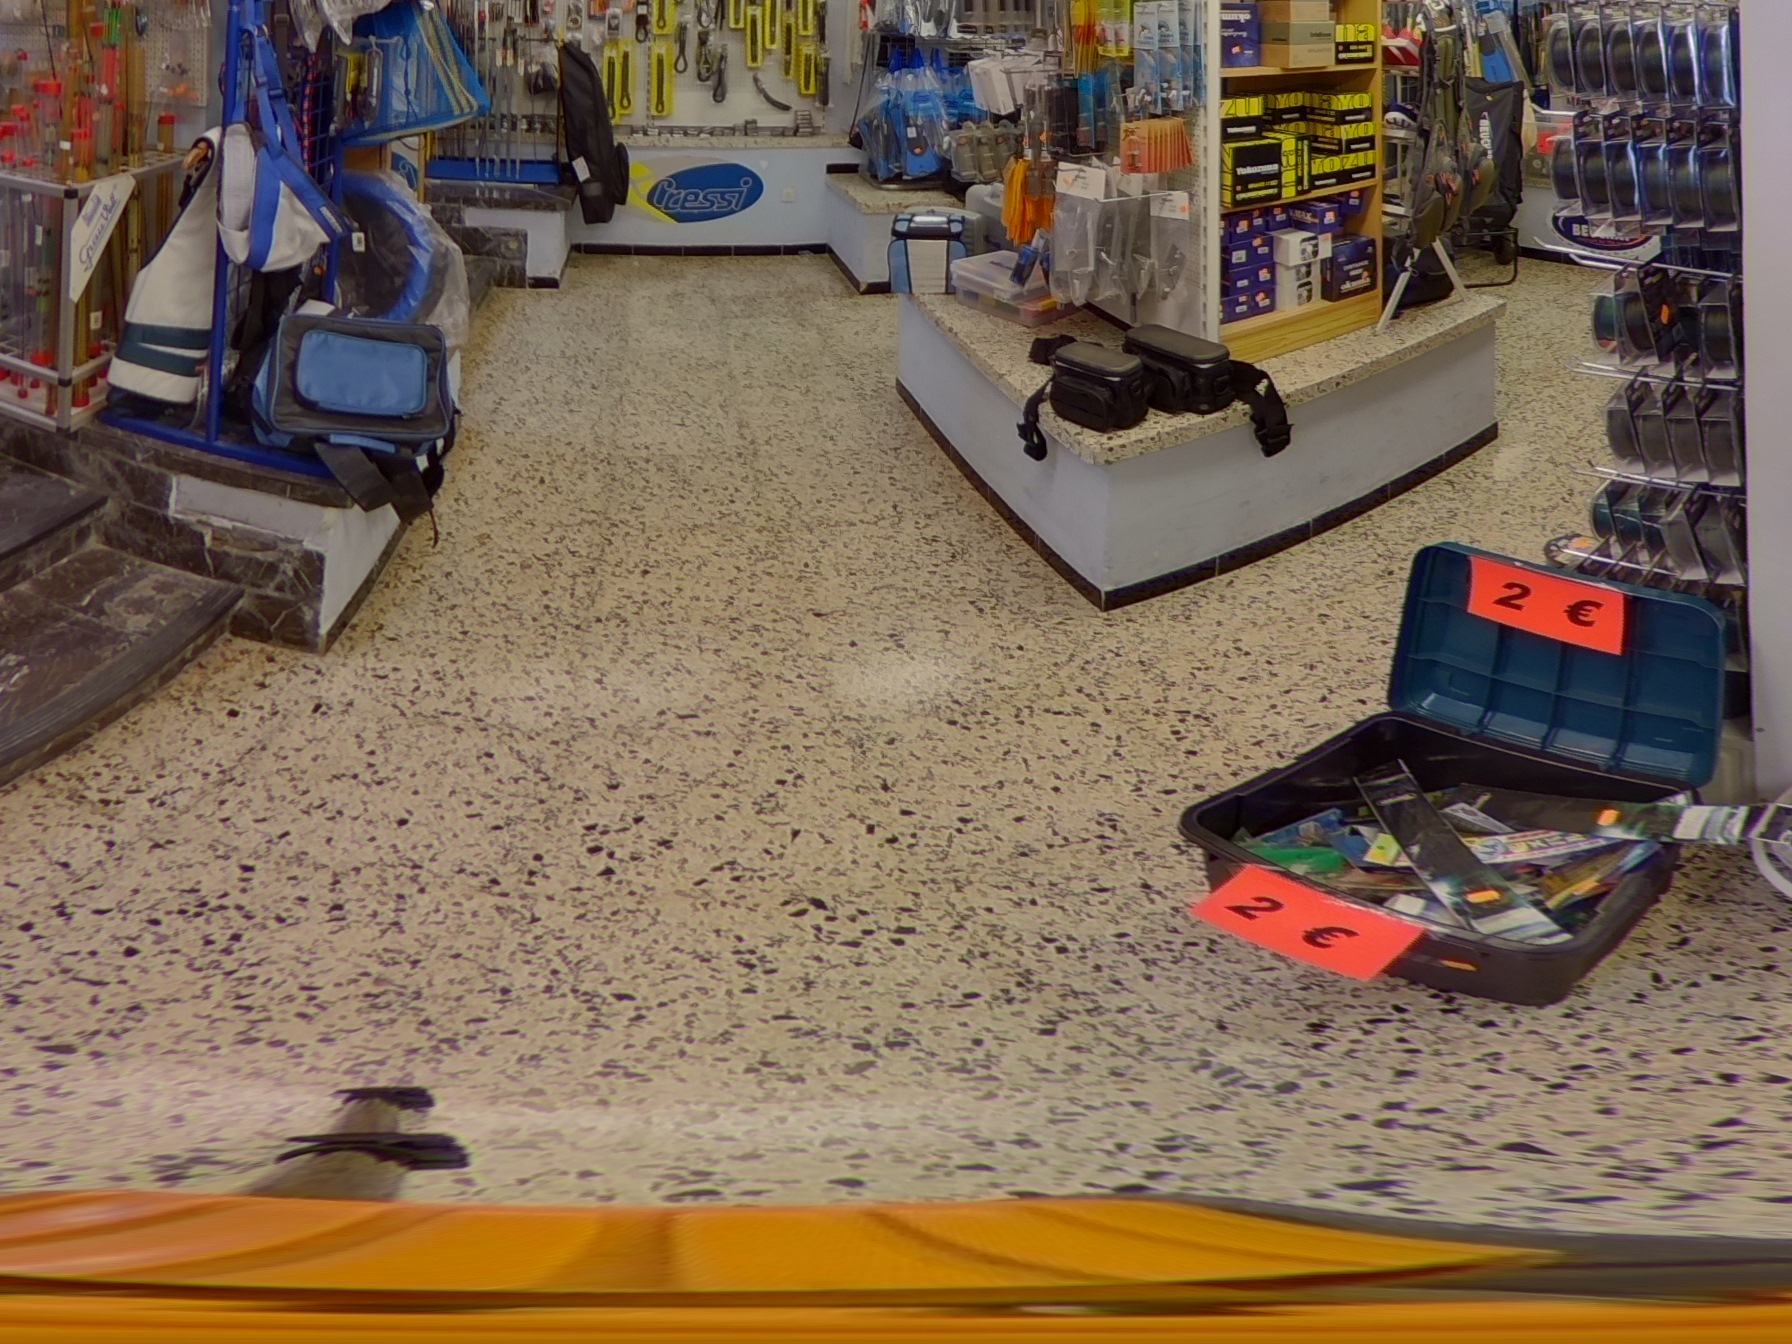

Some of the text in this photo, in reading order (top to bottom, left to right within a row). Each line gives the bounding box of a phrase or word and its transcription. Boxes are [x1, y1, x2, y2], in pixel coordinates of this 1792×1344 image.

[654, 177, 753, 213] Cressi
[1494, 582, 1603, 628] 2 €
[1224, 896, 1359, 950] 2 €
